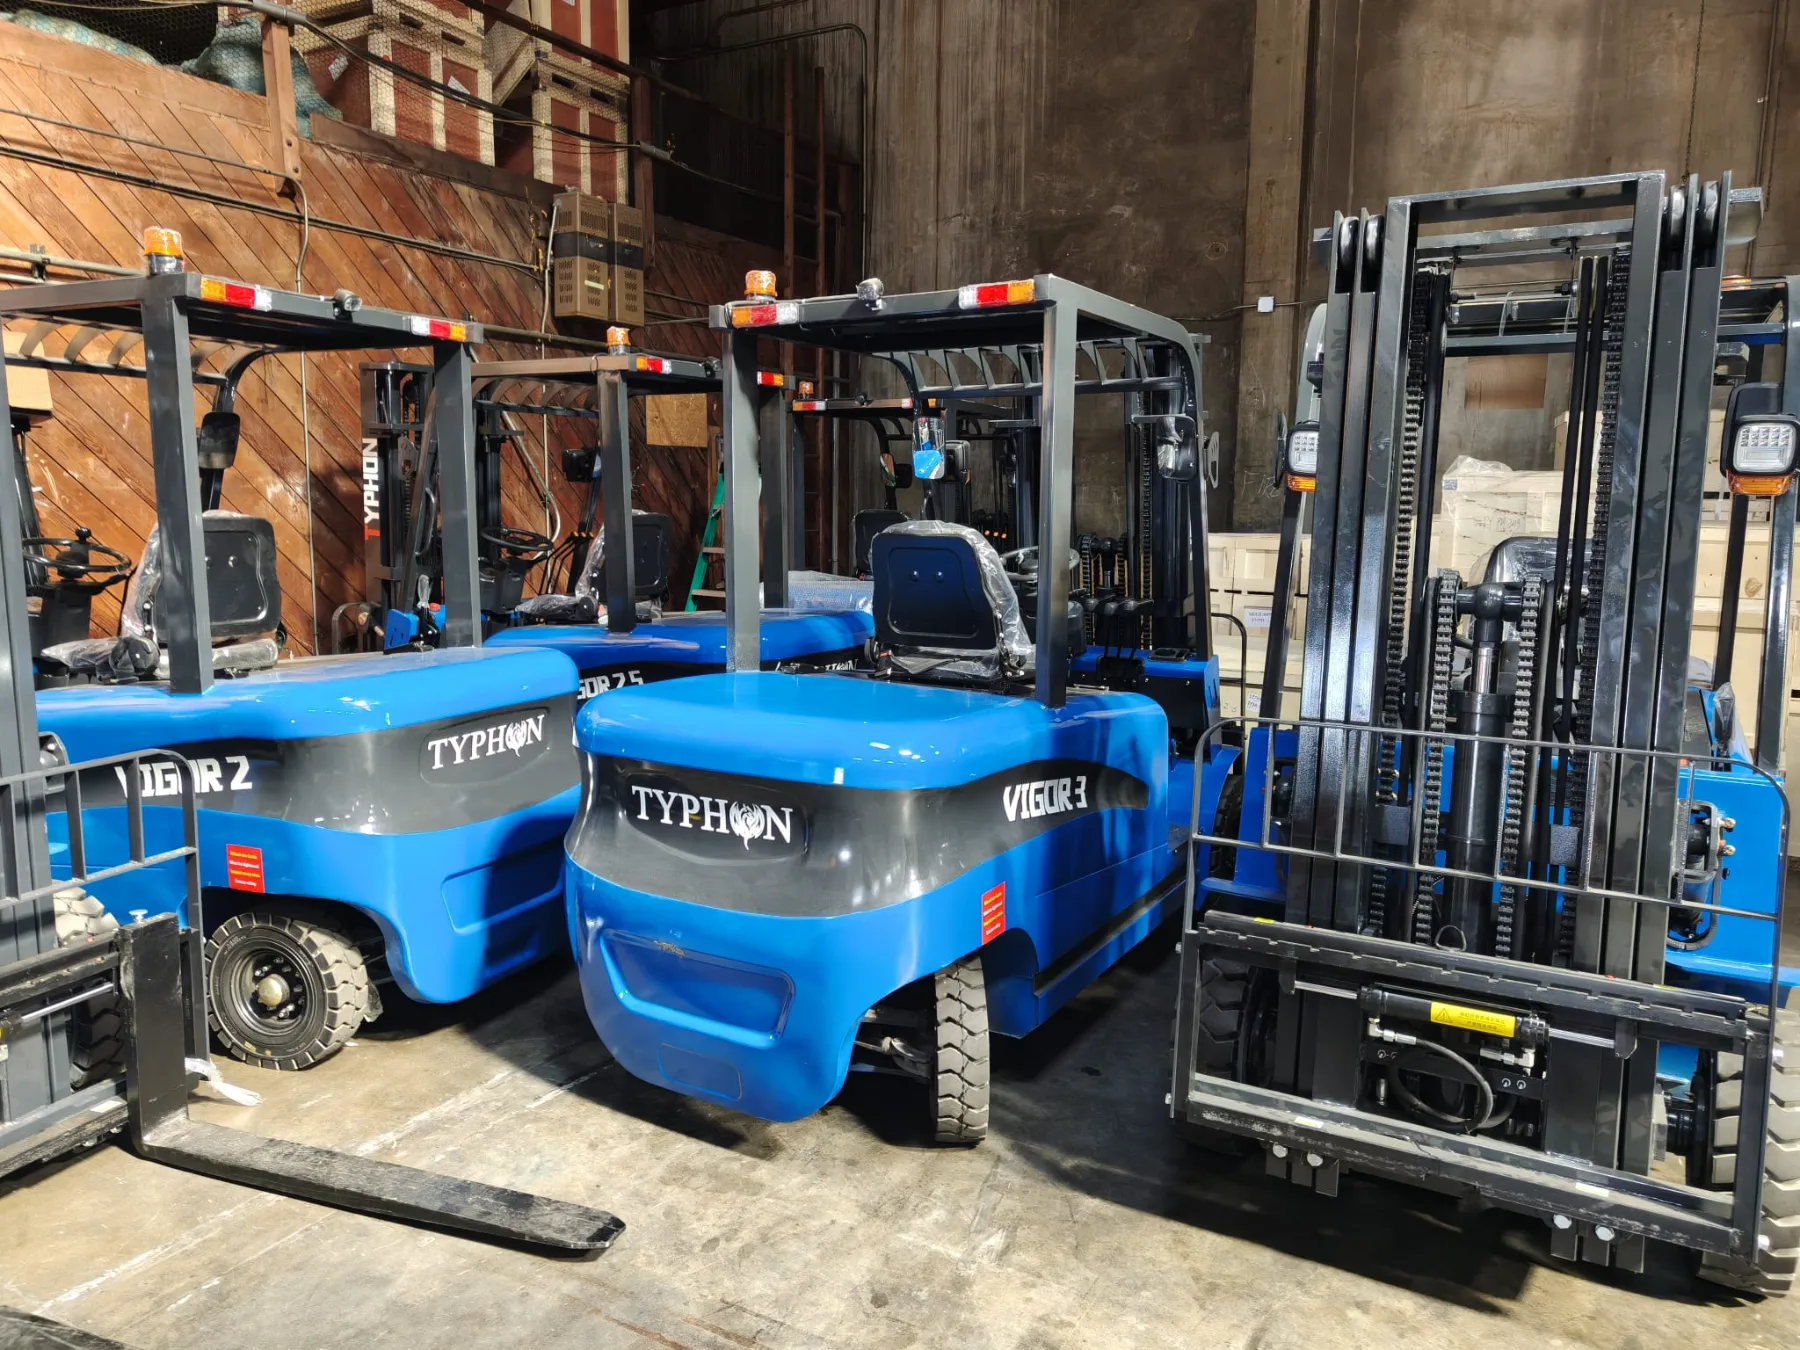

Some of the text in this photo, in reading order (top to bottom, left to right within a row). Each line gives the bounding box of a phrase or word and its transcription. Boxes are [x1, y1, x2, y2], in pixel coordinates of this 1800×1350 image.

[362, 437, 381, 541] TYPHON
[428, 714, 544, 770] TYPHON
[225, 755, 252, 791] 2
[1003, 775, 1088, 822] VIGOR 3
[631, 785, 794, 851] TYPHON
